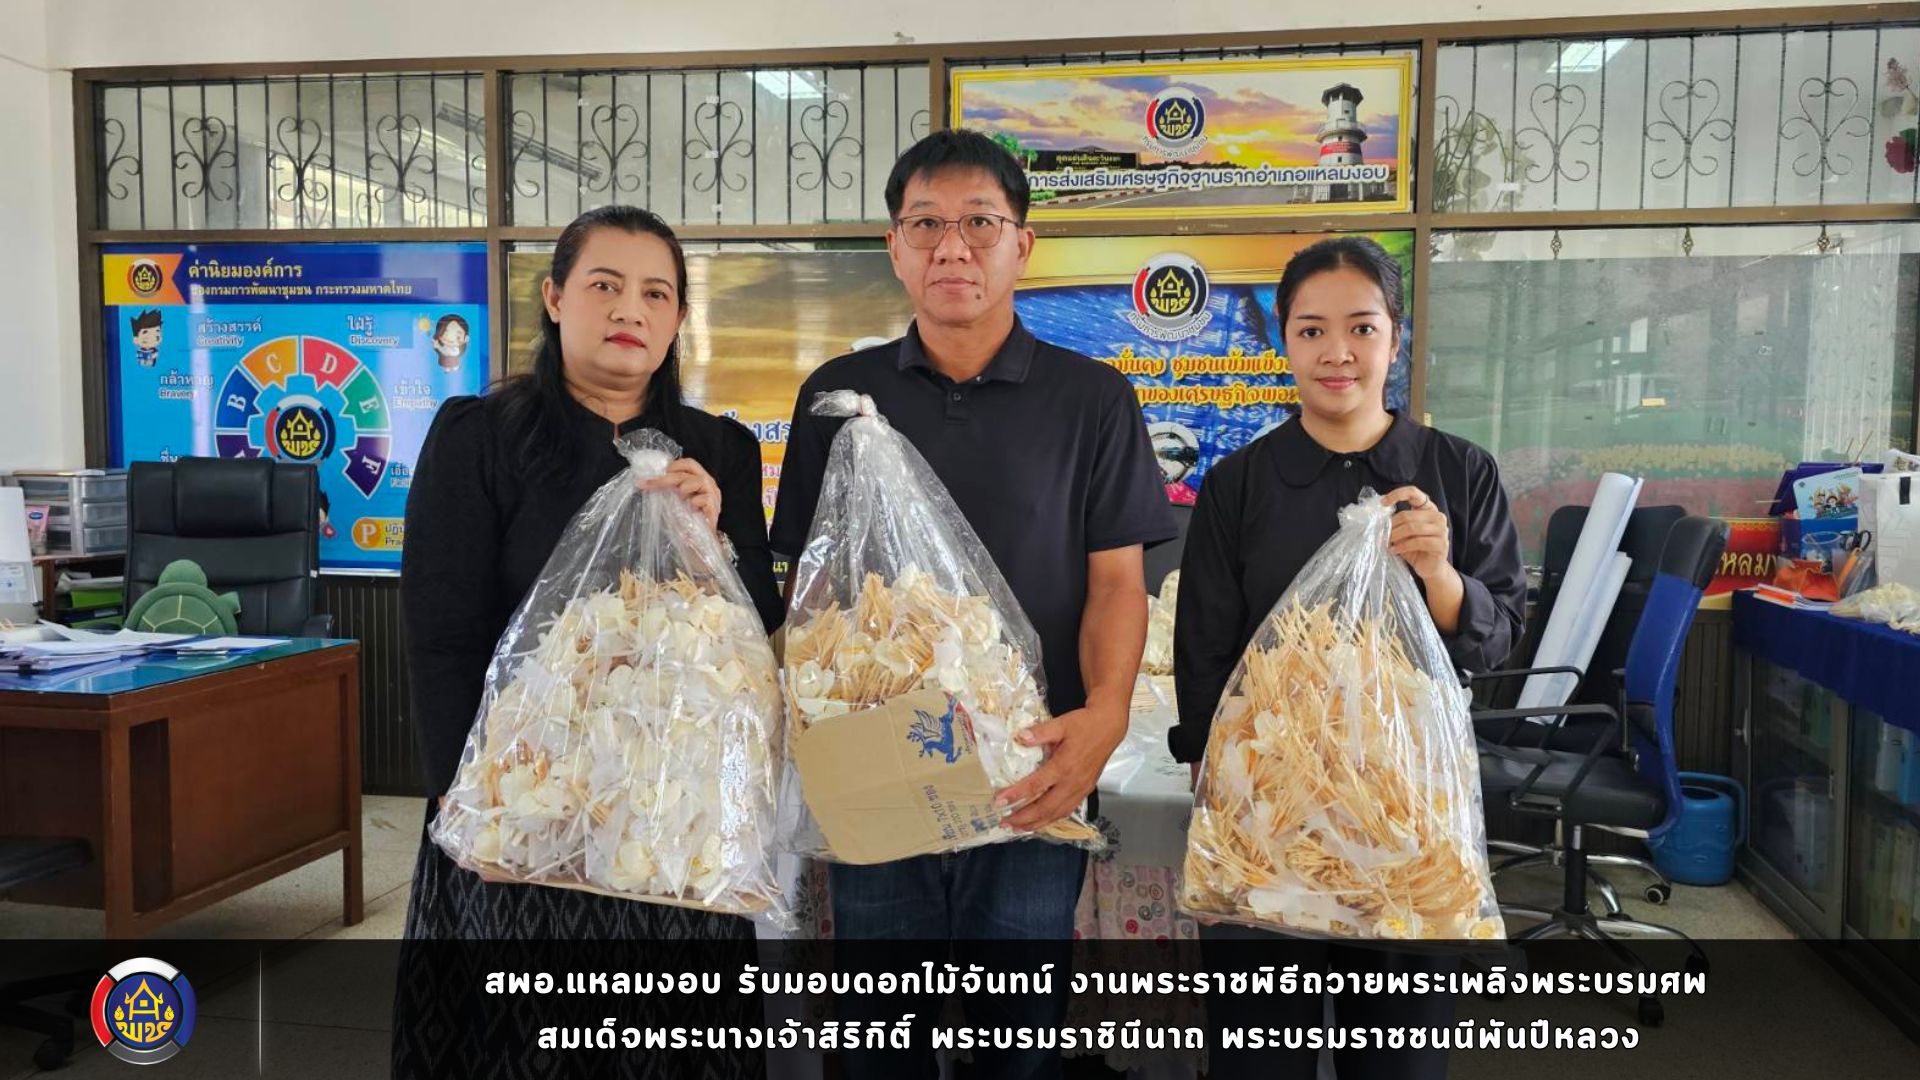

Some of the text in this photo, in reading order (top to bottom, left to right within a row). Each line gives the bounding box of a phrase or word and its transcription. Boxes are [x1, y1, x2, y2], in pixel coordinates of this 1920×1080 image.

[1029, 164, 1387, 190] การส่งเสริมเศรษฐกิจฐานรากอำเภอแหลมงอบ
[188, 257, 303, 278] ค่านิยมองค์การ
[315, 280, 411, 295] กระทรวงมหาดไทย
[198, 316, 262, 333] สร้างสรรค์
[266, 353, 282, 373] C
[320, 352, 337, 374] D
[1172, 350, 1289, 378] ชุมชนเข้มแข็ง
[227, 394, 246, 412] B
[359, 395, 379, 414] E
[1137, 382, 1299, 407] าของเศรษฐกิจพอ
[362, 456, 381, 475] F
[363, 524, 377, 544] P
